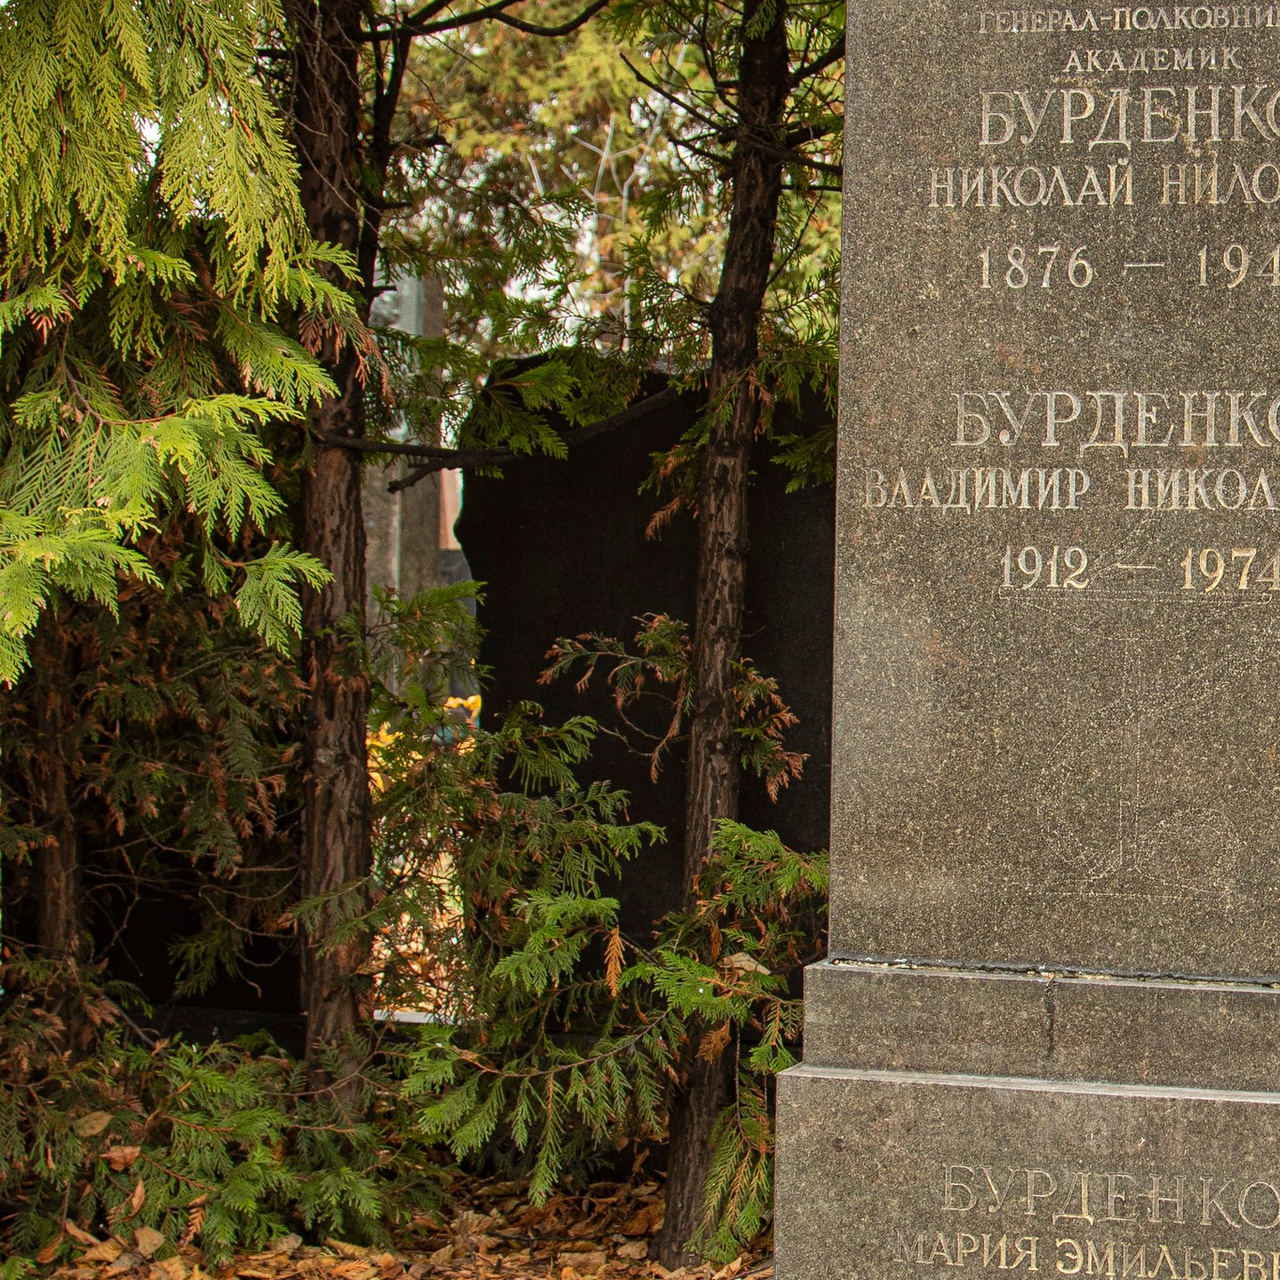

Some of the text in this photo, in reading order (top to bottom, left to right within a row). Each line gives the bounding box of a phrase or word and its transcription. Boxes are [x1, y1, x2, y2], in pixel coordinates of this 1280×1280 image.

[1065, 47, 1242, 75] АКАДЕМИК
[929, 156, 1133, 209] НИКОЛАЙ
[979, 245, 1094, 289] 1876
[863, 468, 1090, 514] ВЛАДИМИР
[1000, 546, 1089, 589] 1912
[896, 1230, 1039, 1271] МАРИЯ
